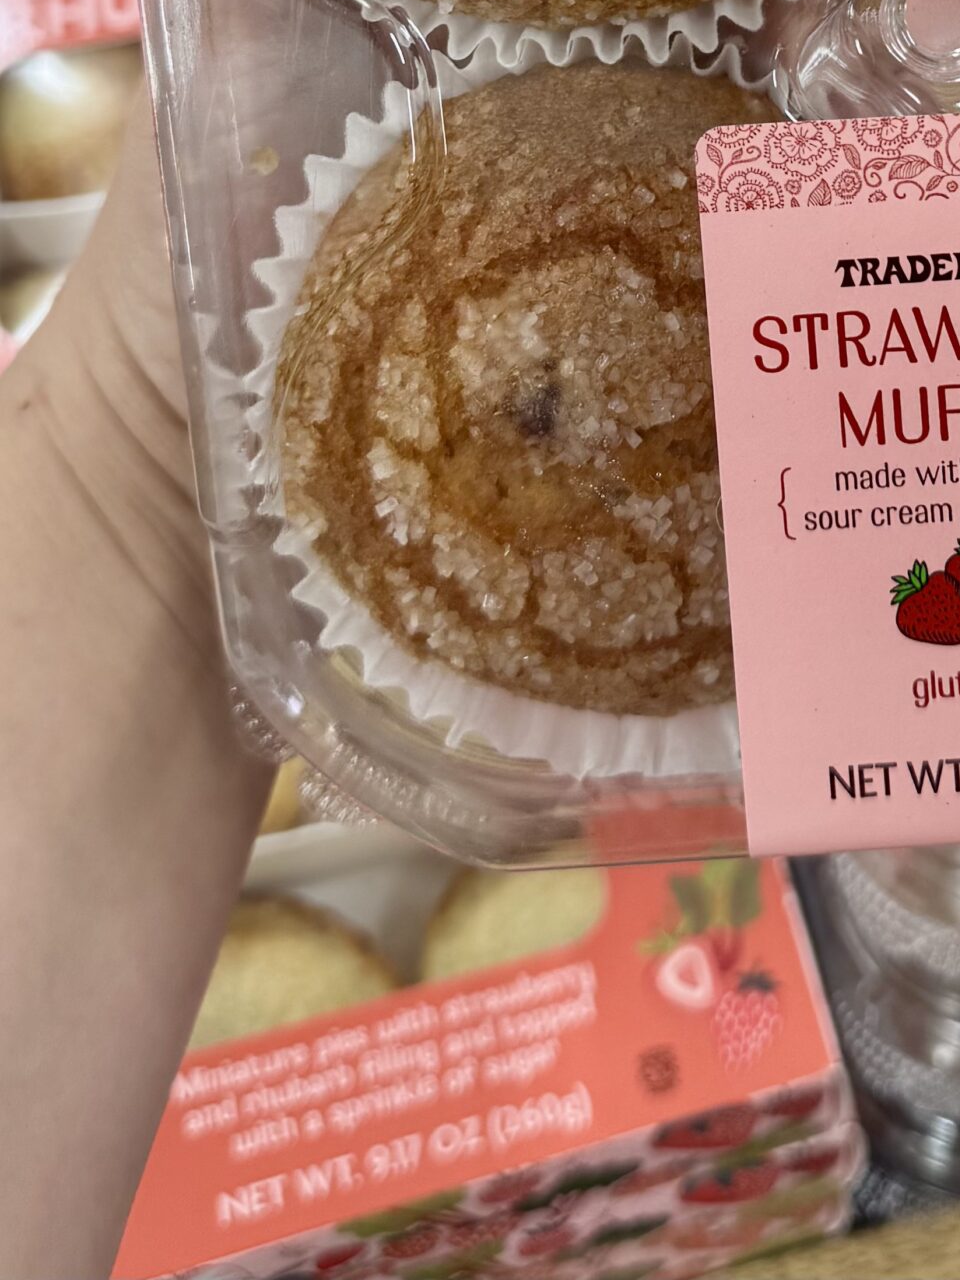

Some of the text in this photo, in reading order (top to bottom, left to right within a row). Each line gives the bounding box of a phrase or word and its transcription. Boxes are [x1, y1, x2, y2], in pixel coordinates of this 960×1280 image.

[835, 462, 906, 491] made
[804, 505, 863, 531] sour
[870, 500, 953, 527] cream
[828, 762, 898, 799] NET
[314, 1025, 368, 1066] pies
[377, 1001, 439, 1041] with
[441, 961, 596, 1021] strawberry
[183, 1094, 238, 1135] and
[442, 1017, 496, 1058] and
[230, 1116, 299, 1158] with
[216, 1174, 288, 1226] NET
[427, 1115, 483, 1161] OZ
